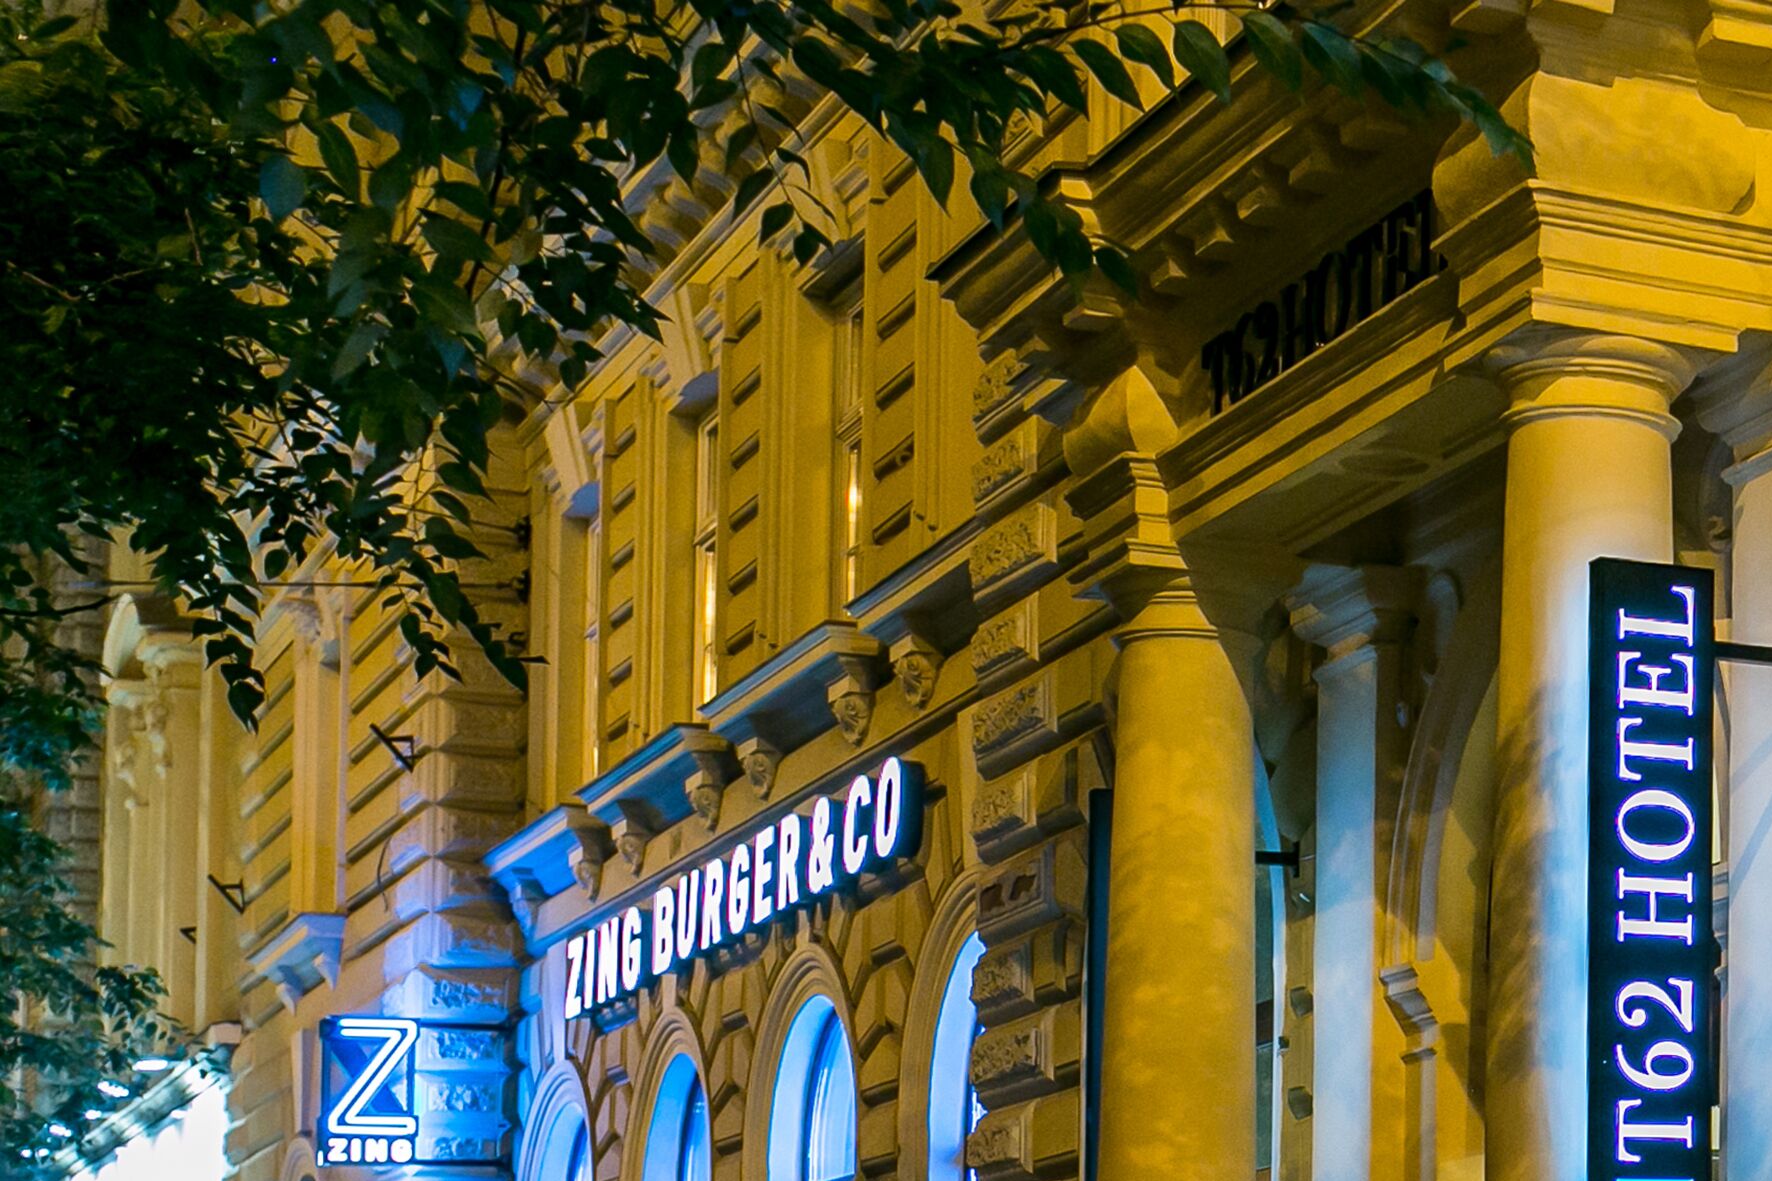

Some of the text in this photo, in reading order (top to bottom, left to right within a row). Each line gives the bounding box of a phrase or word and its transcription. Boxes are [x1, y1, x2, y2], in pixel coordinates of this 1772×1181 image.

[1615, 584, 1696, 1164] T62 HOTEL
[565, 906, 642, 1019] ZING
[326, 1137, 413, 1163] ZING
